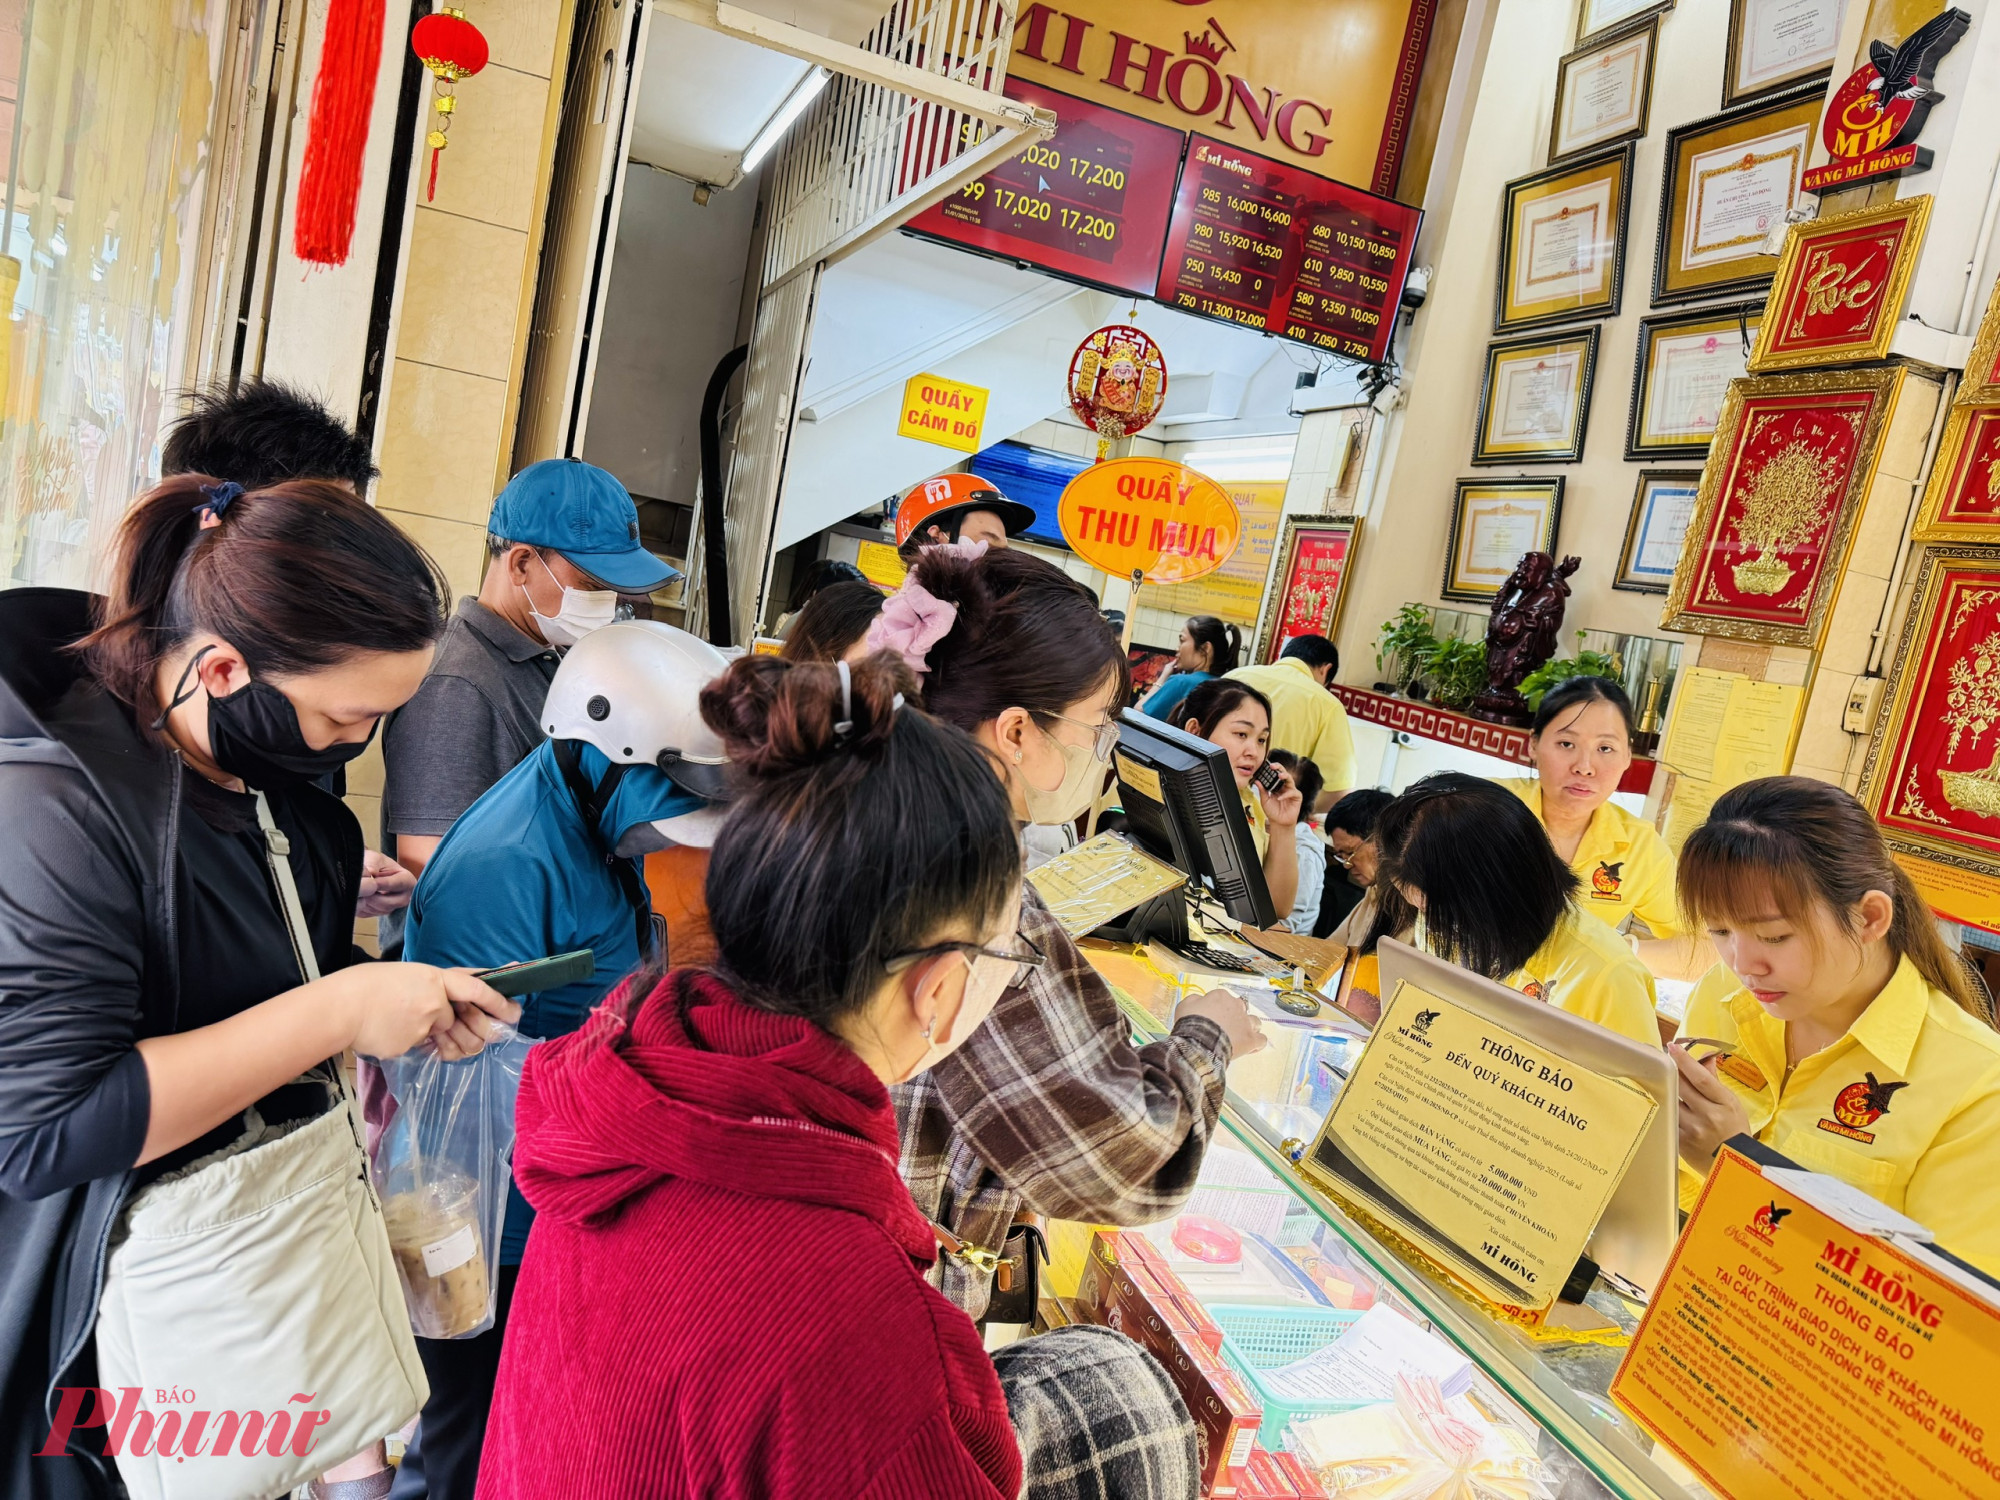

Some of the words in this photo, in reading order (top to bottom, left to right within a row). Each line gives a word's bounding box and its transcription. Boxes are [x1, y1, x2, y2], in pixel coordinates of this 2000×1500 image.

[1832, 112, 1896, 158] MH
[1070, 157, 1125, 190] 17,200
[1804, 168, 1842, 188] VÀNG
[1868, 149, 1912, 172] HỒNG
[994, 188, 1051, 221] 17,020
[1060, 208, 1116, 240] 17,200
[1202, 188, 1221, 204] 985
[1227, 195, 1259, 216] 16,000
[1260, 206, 1291, 226] 16,600
[1194, 223, 1213, 239] 980
[1218, 230, 1250, 250] 15,920
[1252, 241, 1283, 260] 16,520
[1312, 224, 1330, 238] 680
[1336, 232, 1366, 250] 10,150
[1367, 242, 1396, 260] 10,850
[1186, 258, 1205, 274] 950
[1210, 265, 1242, 284] 15,430
[1254, 278, 1262, 291] 0
[1304, 258, 1322, 272] 610
[1330, 266, 1354, 282] 9,850
[1360, 275, 1388, 292] 10,550
[1178, 292, 1196, 308] 750
[1202, 300, 1233, 319] 11,300
[1235, 309, 1266, 328] 12,000
[1296, 292, 1314, 306] 580
[1321, 298, 1346, 316] 9,350
[1350, 308, 1379, 326] 10,050
[1288, 325, 1306, 339] 410
[920, 386, 974, 412] QUẦY
[907, 408, 949, 432] CẦM
[953, 420, 977, 439] ĐỒ
[1116, 472, 1195, 506] QUẦY
[1077, 505, 1140, 548] THU
[1148, 518, 1216, 561] MUA
[1409, 1033, 1432, 1048] HỒNG
[1481, 1037, 1534, 1072] THÔNG
[1537, 1066, 1572, 1091] BÁO
[1445, 1050, 1471, 1069] ĐẾN
[1473, 1065, 1499, 1084] QUÝ
[1500, 1079, 1545, 1108] KHÁCH
[1547, 1103, 1587, 1130] HÀNG
[1820, 1121, 1840, 1132] VÀNG
[1836, 1106, 1871, 1126] MH
[1412, 1135, 1428, 1149] MUA
[1431, 1145, 1451, 1161] VÀNG
[1478, 1174, 1516, 1200] 20.000.000
[1418, 1123, 1433, 1136] BÁN
[1435, 1132, 1455, 1148] VÀNG
[1488, 1164, 1522, 1188] 5.000.000
[1499, 1254, 1537, 1282] HỒNG
[1821, 1240, 1859, 1274] MỈ
[1860, 1265, 1942, 1326] HỒNG
[1815, 1284, 1870, 1331] THÔNG
[1874, 1325, 1913, 1359] BÁO
[1715, 1266, 1732, 1285] TẠI
[1732, 1280, 1756, 1302] CÁC
[1757, 1298, 1780, 1321] CỬA
[1782, 1315, 1816, 1346] HÀNG
[1819, 1340, 1862, 1379] TRONG
[1864, 1374, 1884, 1395] HỆ
[1887, 1389, 1935, 1432] THỐNG
[1938, 1426, 1958, 1448] MI
[1738, 1264, 1761, 1284] QUY
[1764, 1280, 1797, 1311] TRÌNH
[1798, 1306, 1828, 1332] GIAO
[1829, 1327, 1861, 1356] DỊCH
[1864, 1350, 1886, 1373] VỚI
[1887, 1368, 1937, 1409] KHÁCH
[1940, 1404, 1984, 1443] HÀNG
